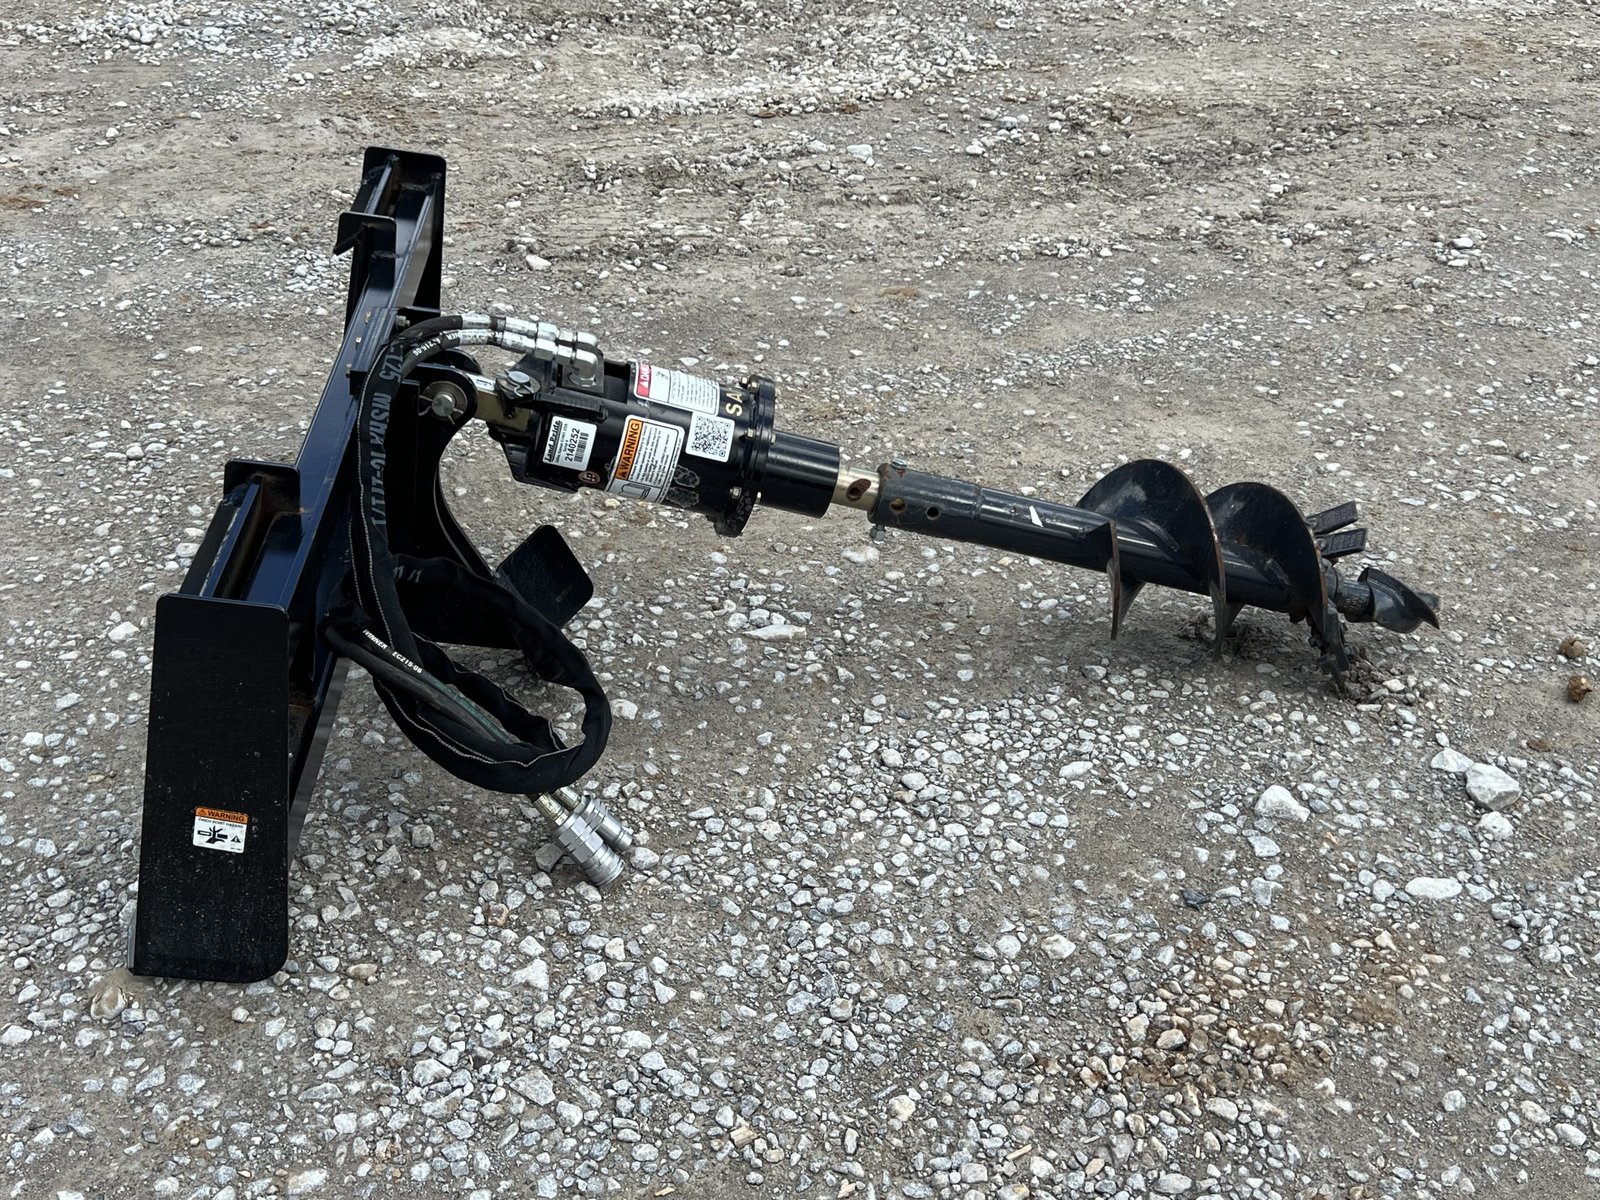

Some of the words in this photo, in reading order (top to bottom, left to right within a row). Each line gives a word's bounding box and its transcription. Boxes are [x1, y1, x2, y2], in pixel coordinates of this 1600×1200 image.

[565, 428, 580, 462] 2140252
[620, 422, 640, 470] WARNING
[208, 810, 244, 821] WARNING
